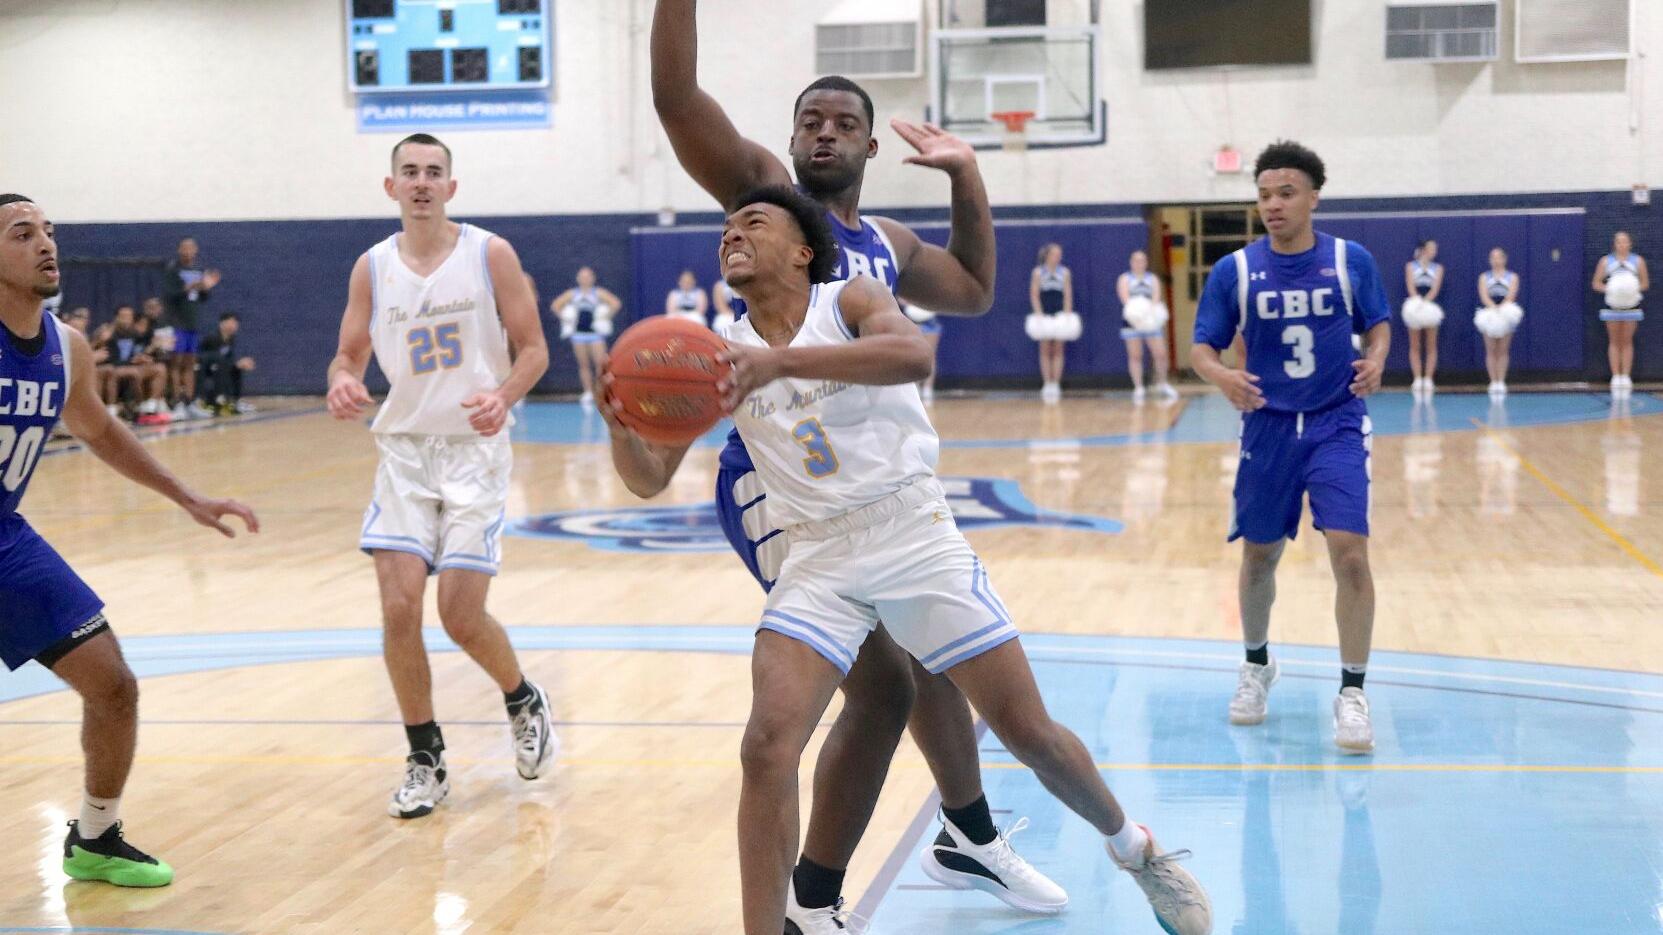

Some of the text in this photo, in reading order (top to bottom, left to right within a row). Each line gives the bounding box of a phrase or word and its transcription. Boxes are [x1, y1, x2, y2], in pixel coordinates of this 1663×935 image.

[410, 103, 464, 118] HOUSE
[468, 101, 545, 117] PRINTING
[386, 298, 475, 325] The Mountain
[1256, 288, 1334, 320] CBC
[407, 322, 463, 376] 25
[1281, 324, 1315, 379] 3
[747, 394, 776, 419] The
[791, 416, 840, 480] 3
